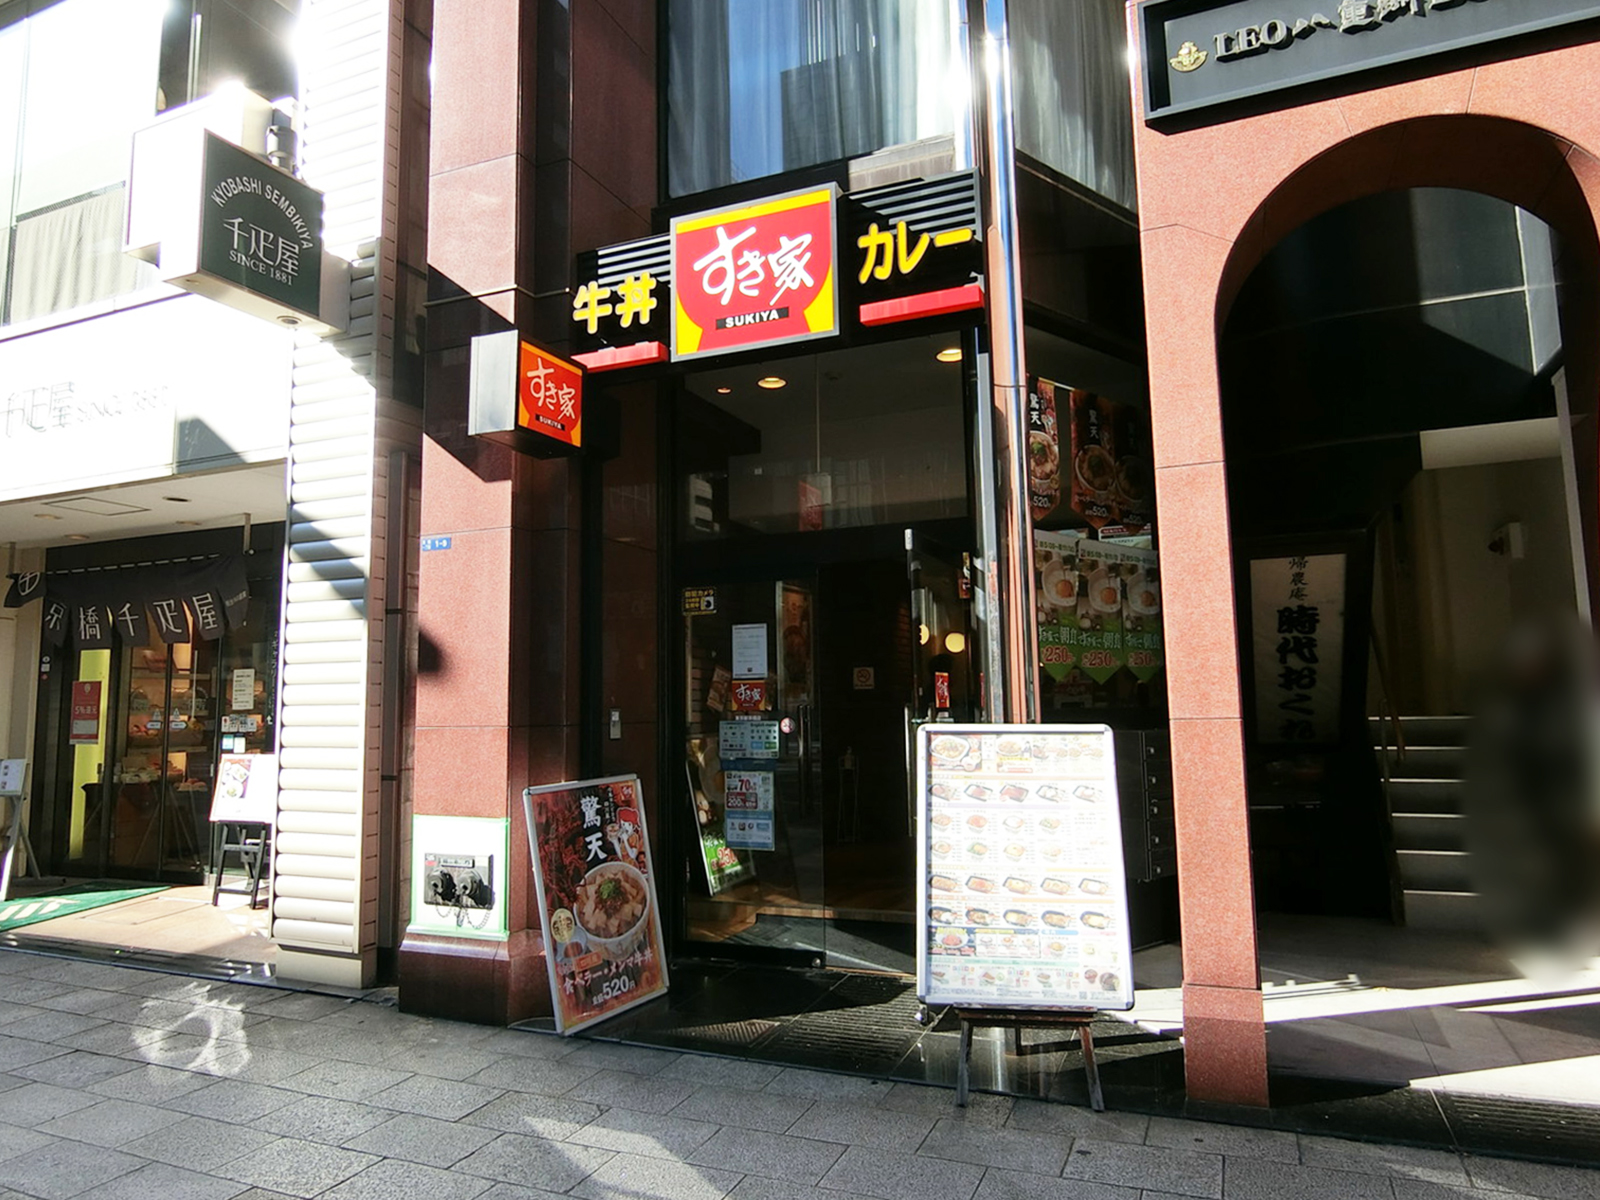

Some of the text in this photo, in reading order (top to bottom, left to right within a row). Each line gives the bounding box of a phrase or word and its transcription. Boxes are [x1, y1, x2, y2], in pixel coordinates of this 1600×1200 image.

[211, 176, 314, 249] KYOBASHI SEMBIKIYA
[223, 217, 299, 276] 千疋屋
[229, 250, 292, 286] SINCE 1881
[693, 226, 815, 306] すき家
[857, 220, 973, 284] カレー
[572, 271, 658, 335] 牛丼
[724, 309, 780, 328] SUKIYA
[526, 357, 576, 420] すき家
[579, 795, 607, 862] 驚天
